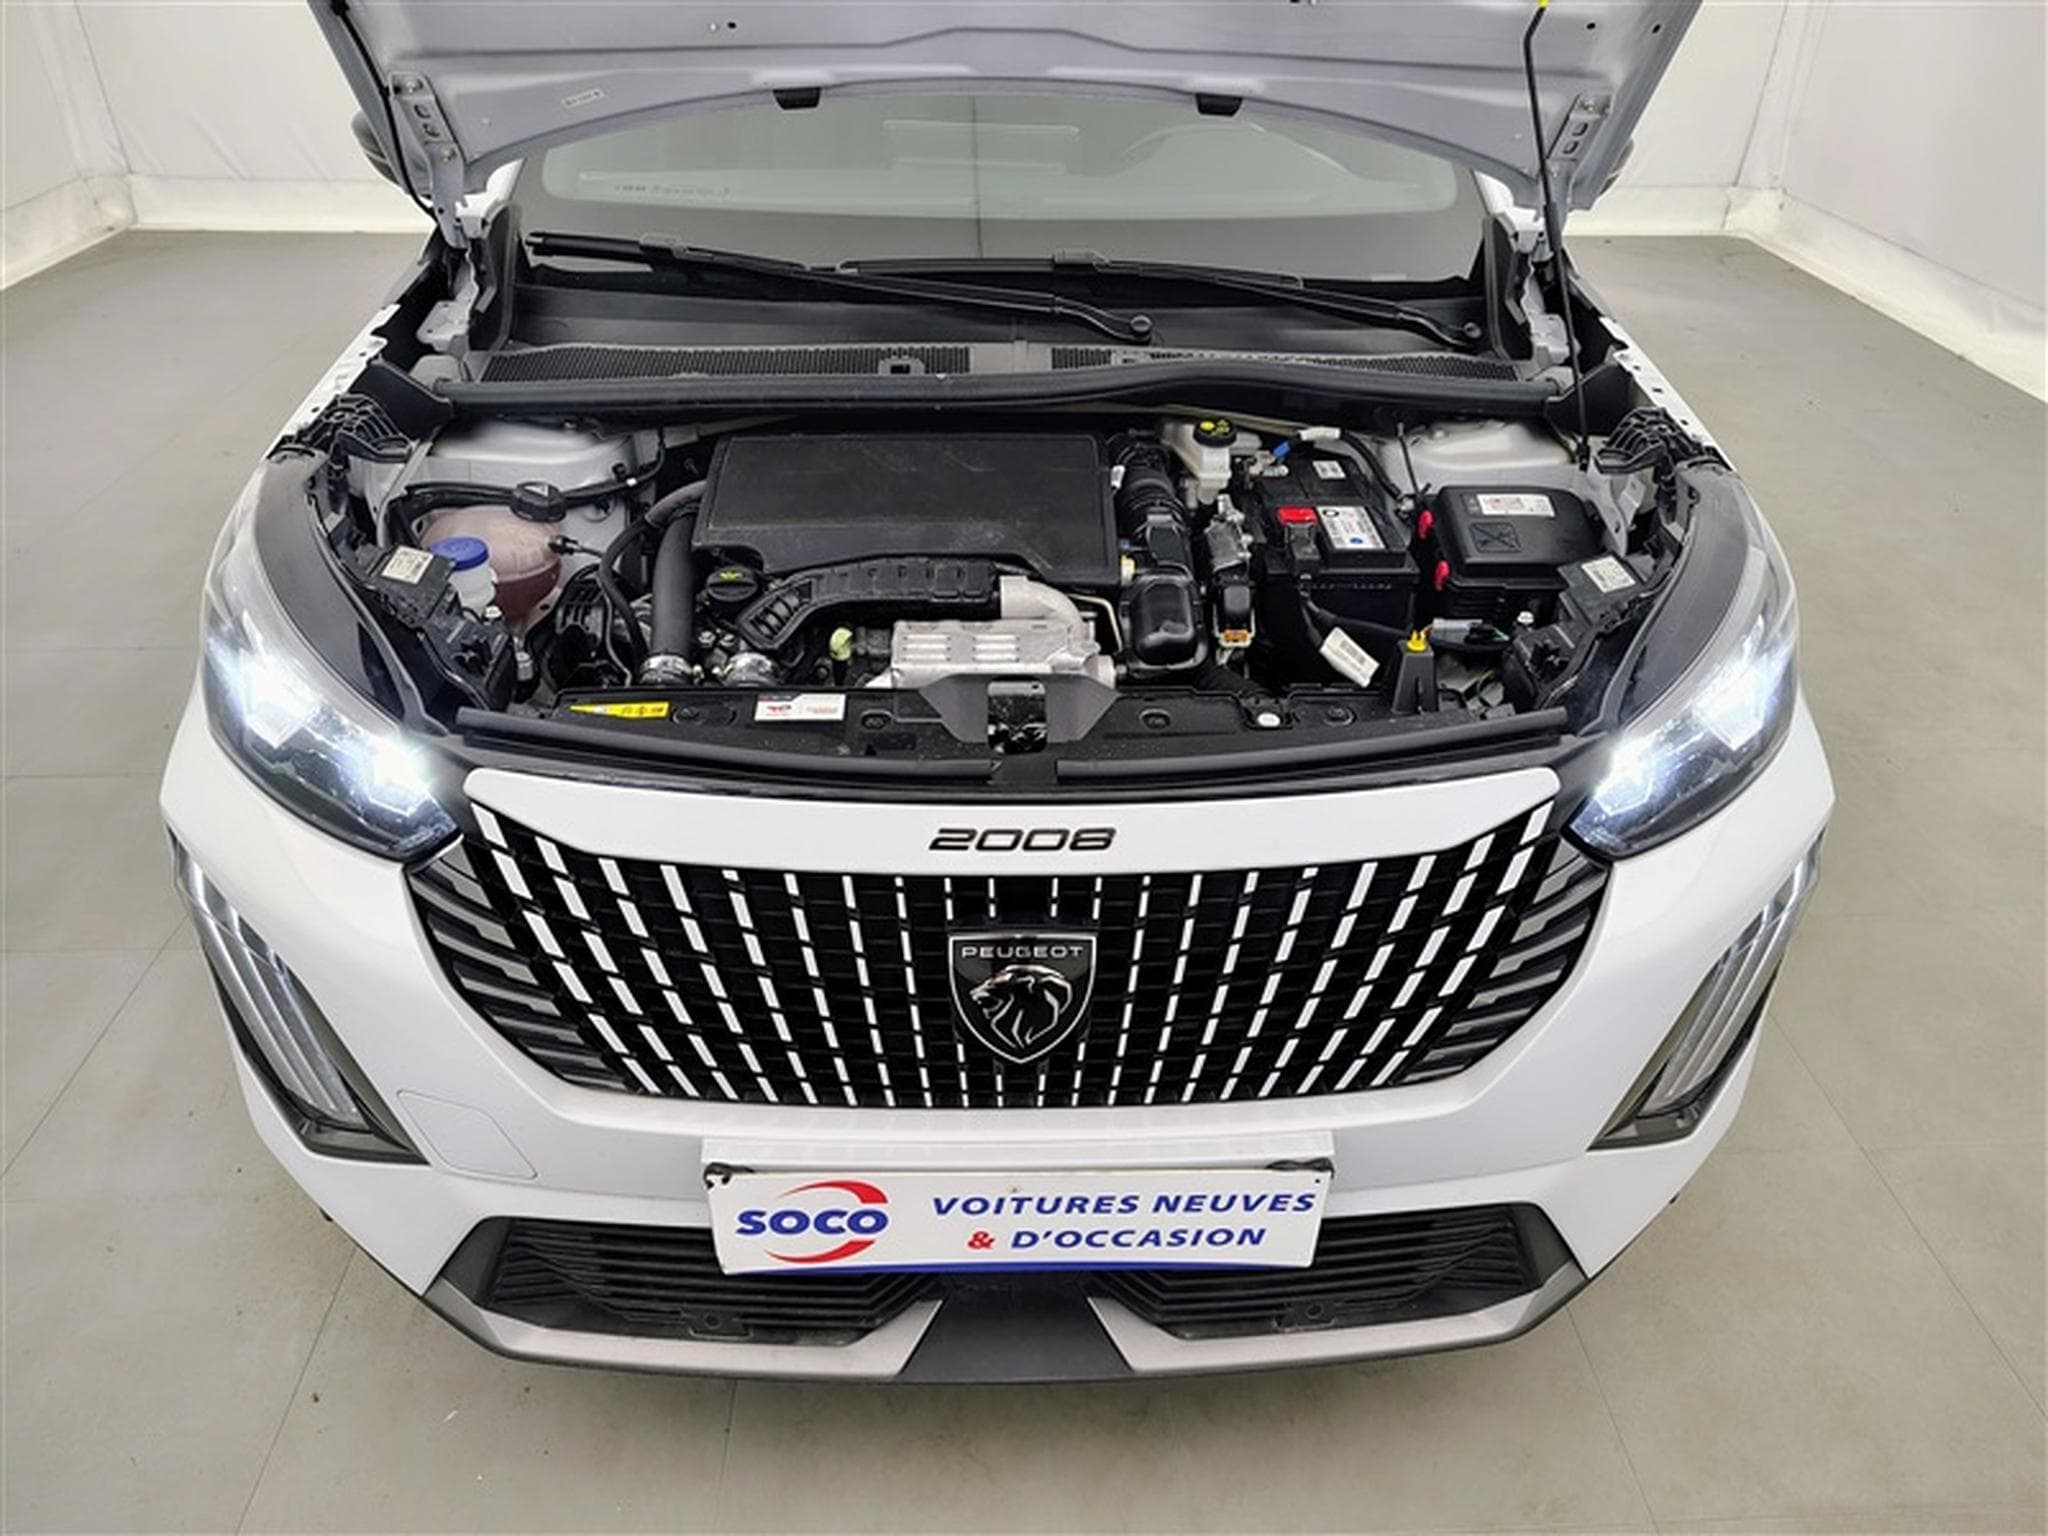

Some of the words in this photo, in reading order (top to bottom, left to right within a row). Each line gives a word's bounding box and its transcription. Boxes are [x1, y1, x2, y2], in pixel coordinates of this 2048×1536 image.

[929, 827, 1117, 851] 2008
[961, 946, 1084, 959] PEUGEOT
[932, 1194, 1141, 1216] VOITURES
[1152, 1193, 1317, 1214] NEUVES
[736, 1208, 889, 1236] SOCO
[967, 1230, 996, 1250] &
[1011, 1228, 1267, 1249] D'OCCASION
